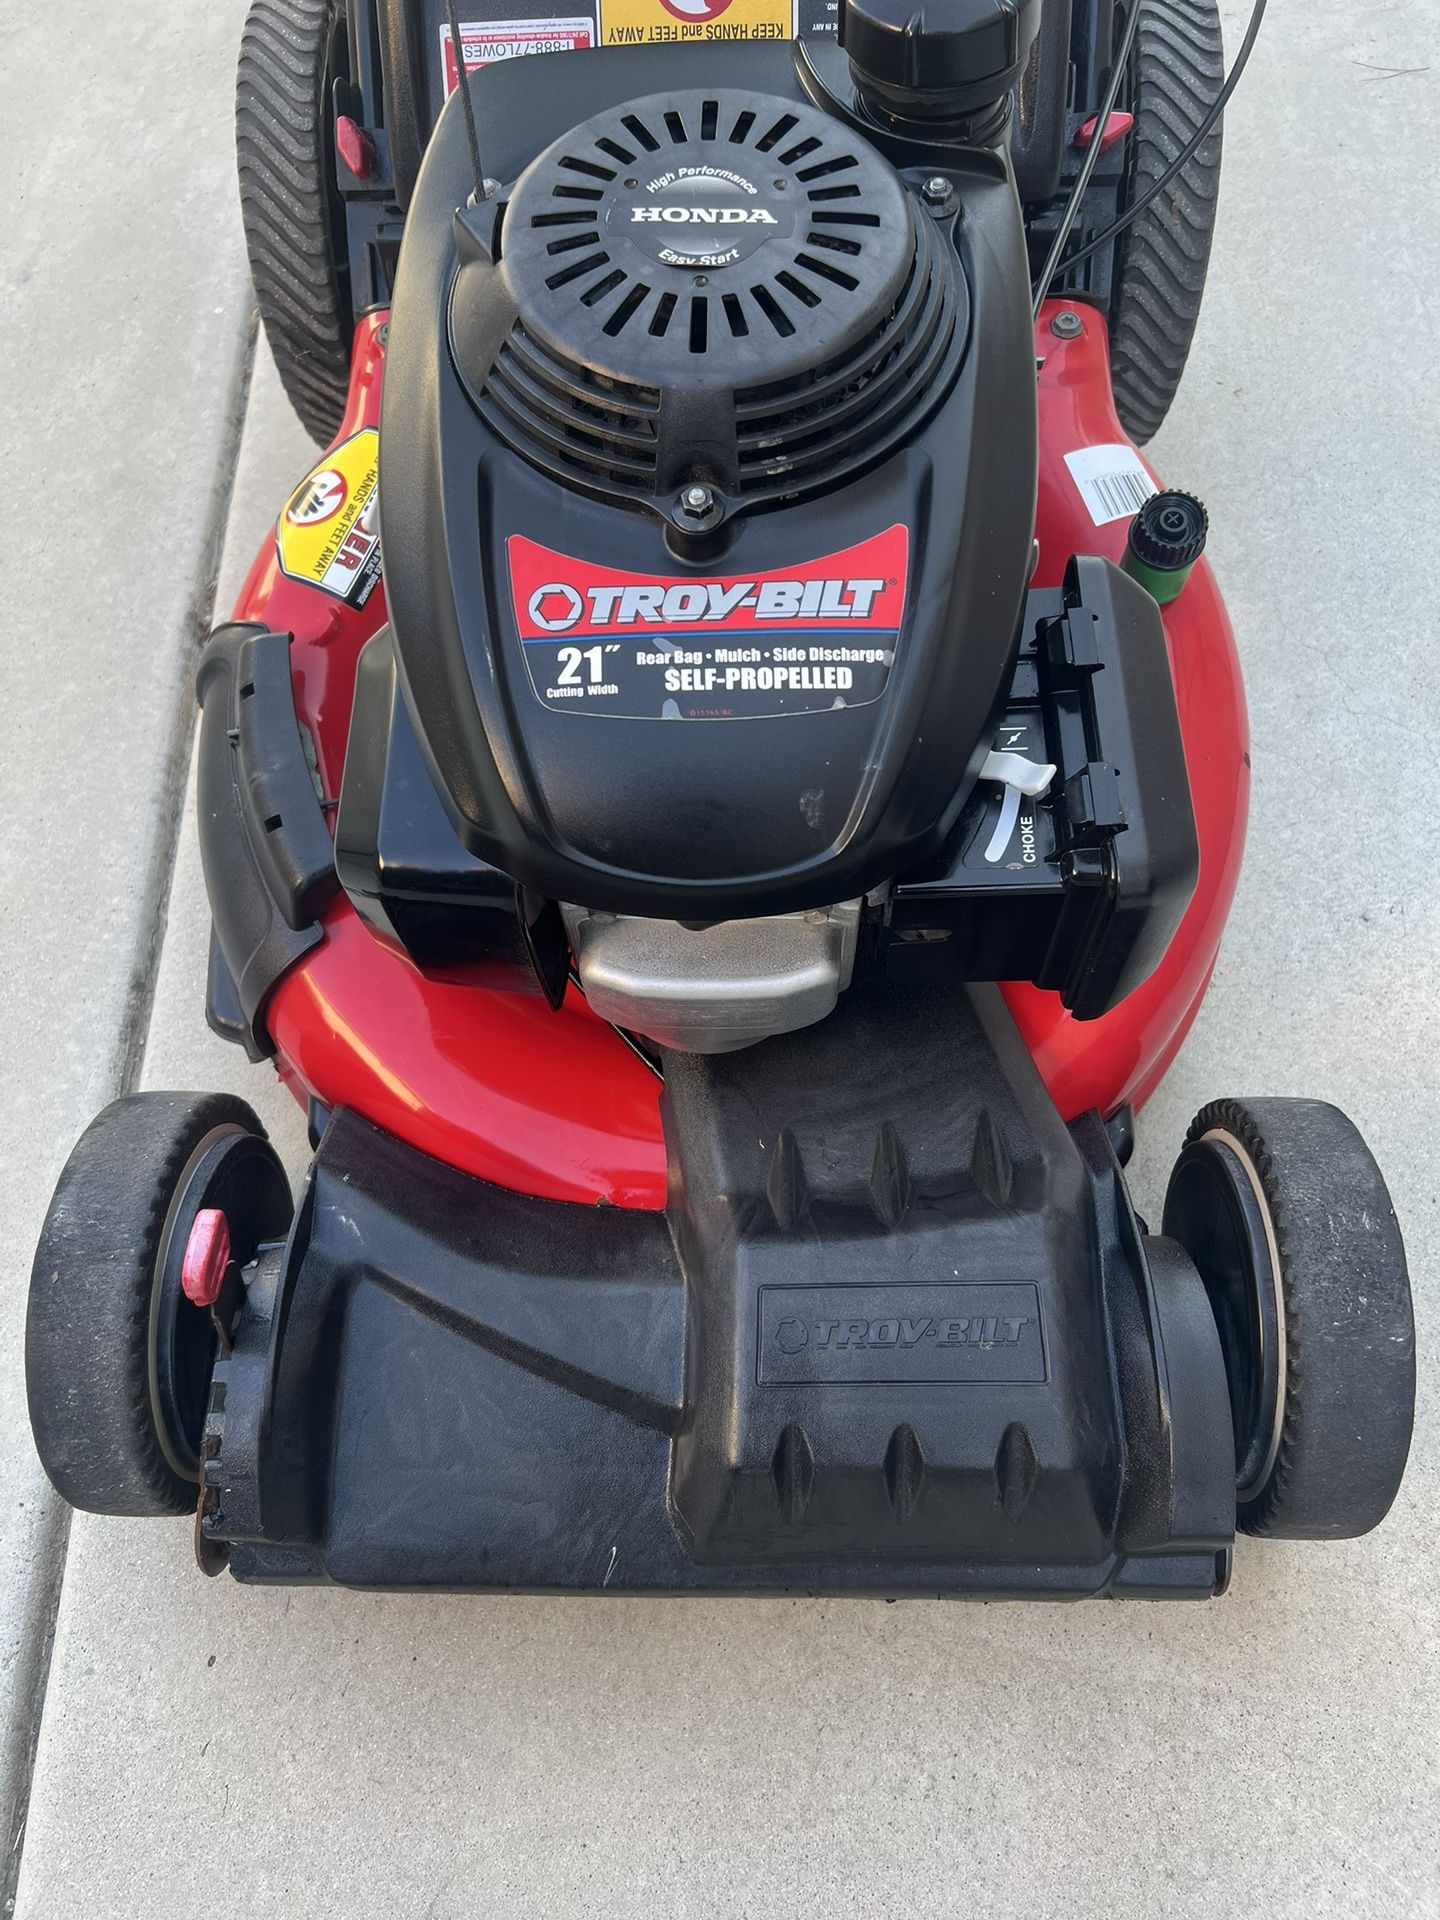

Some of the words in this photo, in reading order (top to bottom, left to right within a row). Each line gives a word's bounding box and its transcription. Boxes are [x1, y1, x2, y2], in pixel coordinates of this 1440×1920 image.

[609, 26, 645, 42] AWAY
[648, 25, 678, 41] FEET
[681, 24, 703, 38] and
[706, 23, 748, 39] HANDS
[752, 23, 784, 38] KEEP
[812, 23, 825, 31] ANY
[464, 41, 570, 58] 1-888-77LOWES
[646, 172, 676, 194] High
[678, 165, 758, 195] Performance
[631, 207, 778, 224] HONDA
[658, 248, 696, 265] Easy
[700, 248, 740, 265] Start
[352, 468, 378, 503] HANDS
[342, 503, 357, 522] and
[331, 522, 350, 548] FEET
[312, 545, 335, 577] AWAY
[586, 579, 886, 624] TROY-BILT
[636, 650, 672, 665] Rear
[673, 650, 703, 665] Bag
[714, 648, 761, 662] Mulch
[773, 647, 807, 662] Side
[809, 646, 884, 663] Discharge
[664, 667, 853, 691] SELF-PROPELLED
[546, 686, 584, 698] Cutting
[587, 684, 619, 696] Width
[1020, 816, 1036, 863] CHOKE
[814, 1316, 1029, 1350] TROY-BILT
